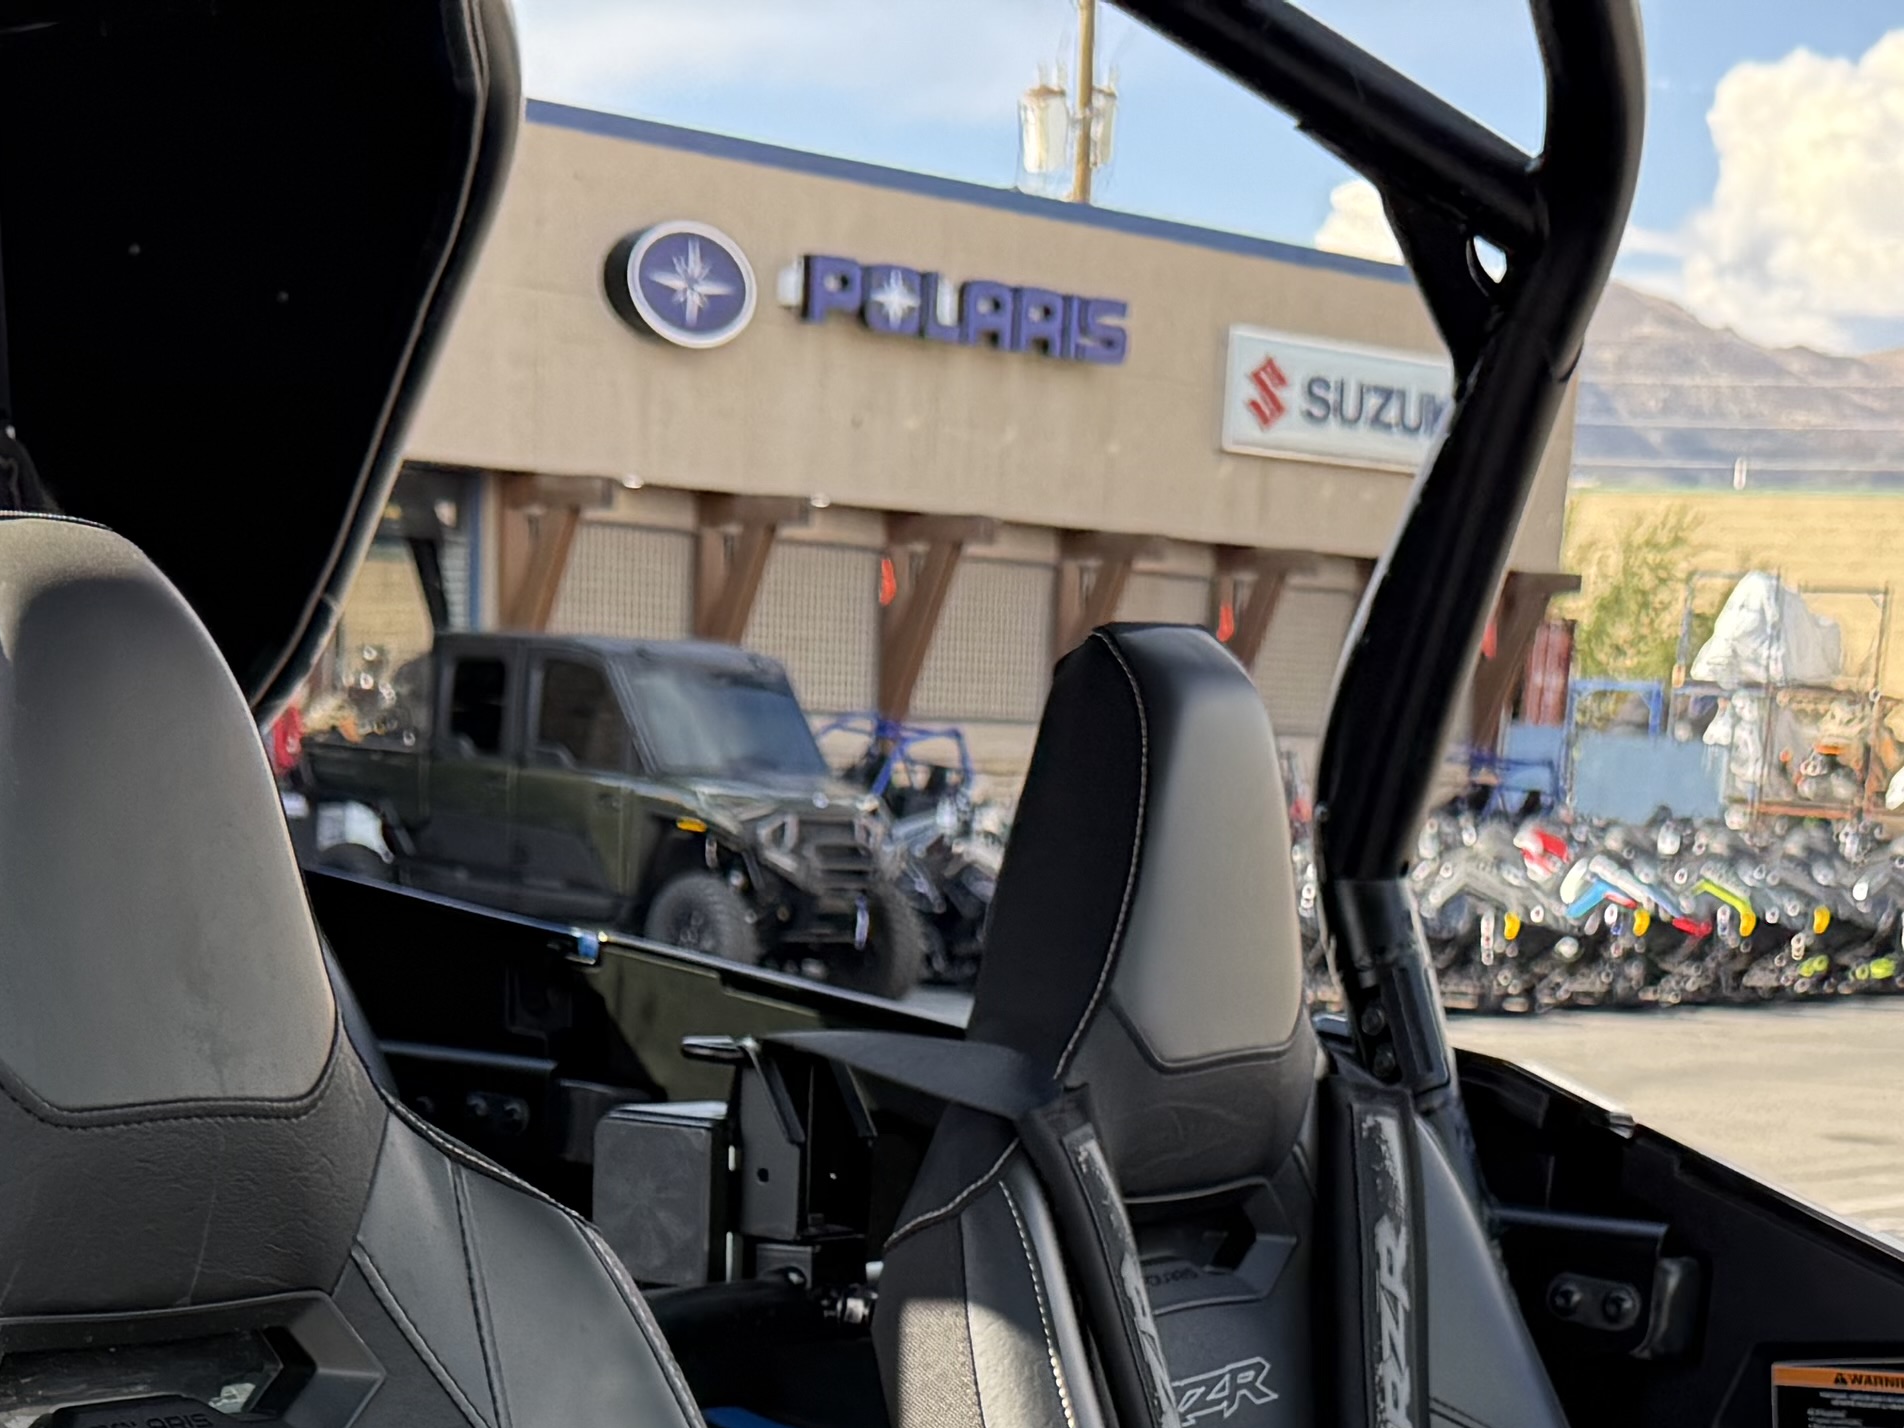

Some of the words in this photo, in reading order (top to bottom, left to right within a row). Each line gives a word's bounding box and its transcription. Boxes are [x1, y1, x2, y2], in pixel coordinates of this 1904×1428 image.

[801, 254, 1128, 366] POLARIS
[1306, 376, 1450, 437] SUZUK
[1170, 1356, 1279, 1427] ZR
